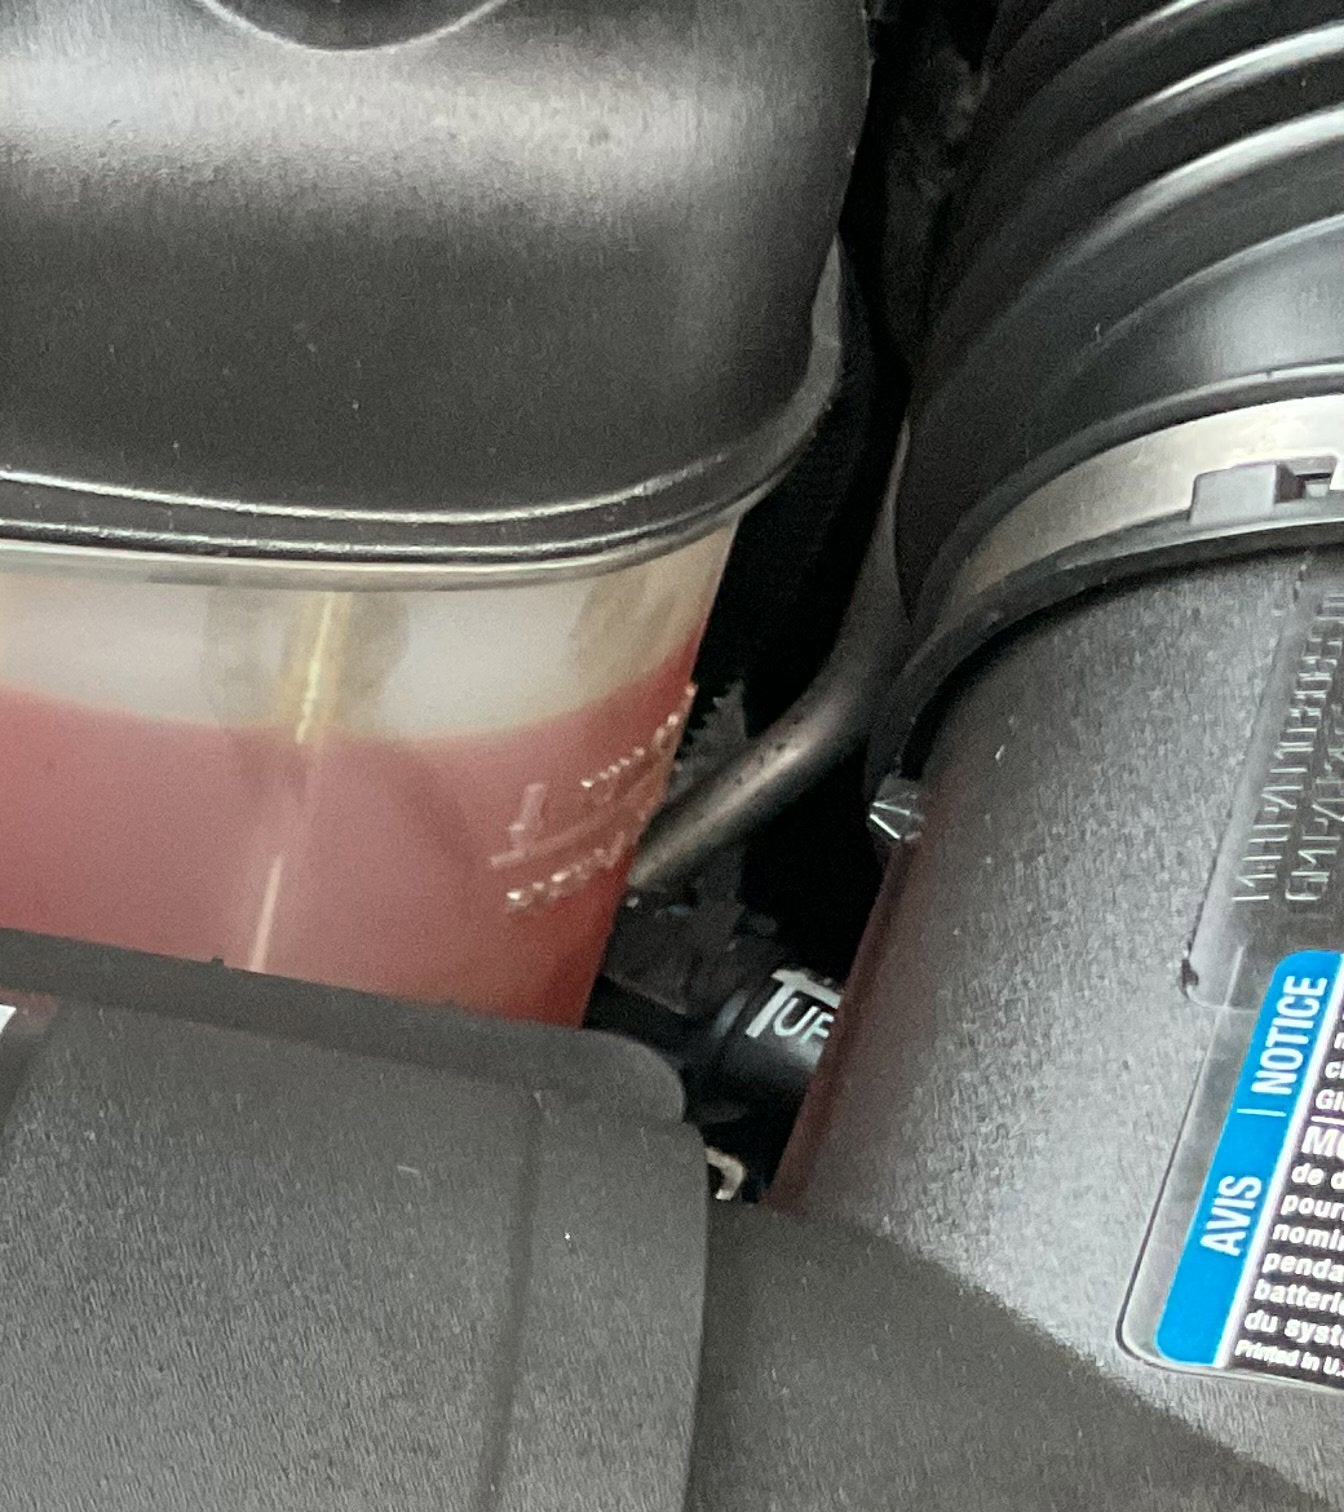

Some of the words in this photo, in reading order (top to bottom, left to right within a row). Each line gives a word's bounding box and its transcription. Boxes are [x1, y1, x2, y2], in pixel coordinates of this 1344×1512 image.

[1251, 976, 1328, 1095] NOTICE
[1291, 1163, 1324, 1185] de
[1200, 1175, 1262, 1256] AVIS
[1244, 1310, 1278, 1333] du
[1235, 1339, 1300, 1367] Printed
[1300, 1352, 1321, 1371] in
